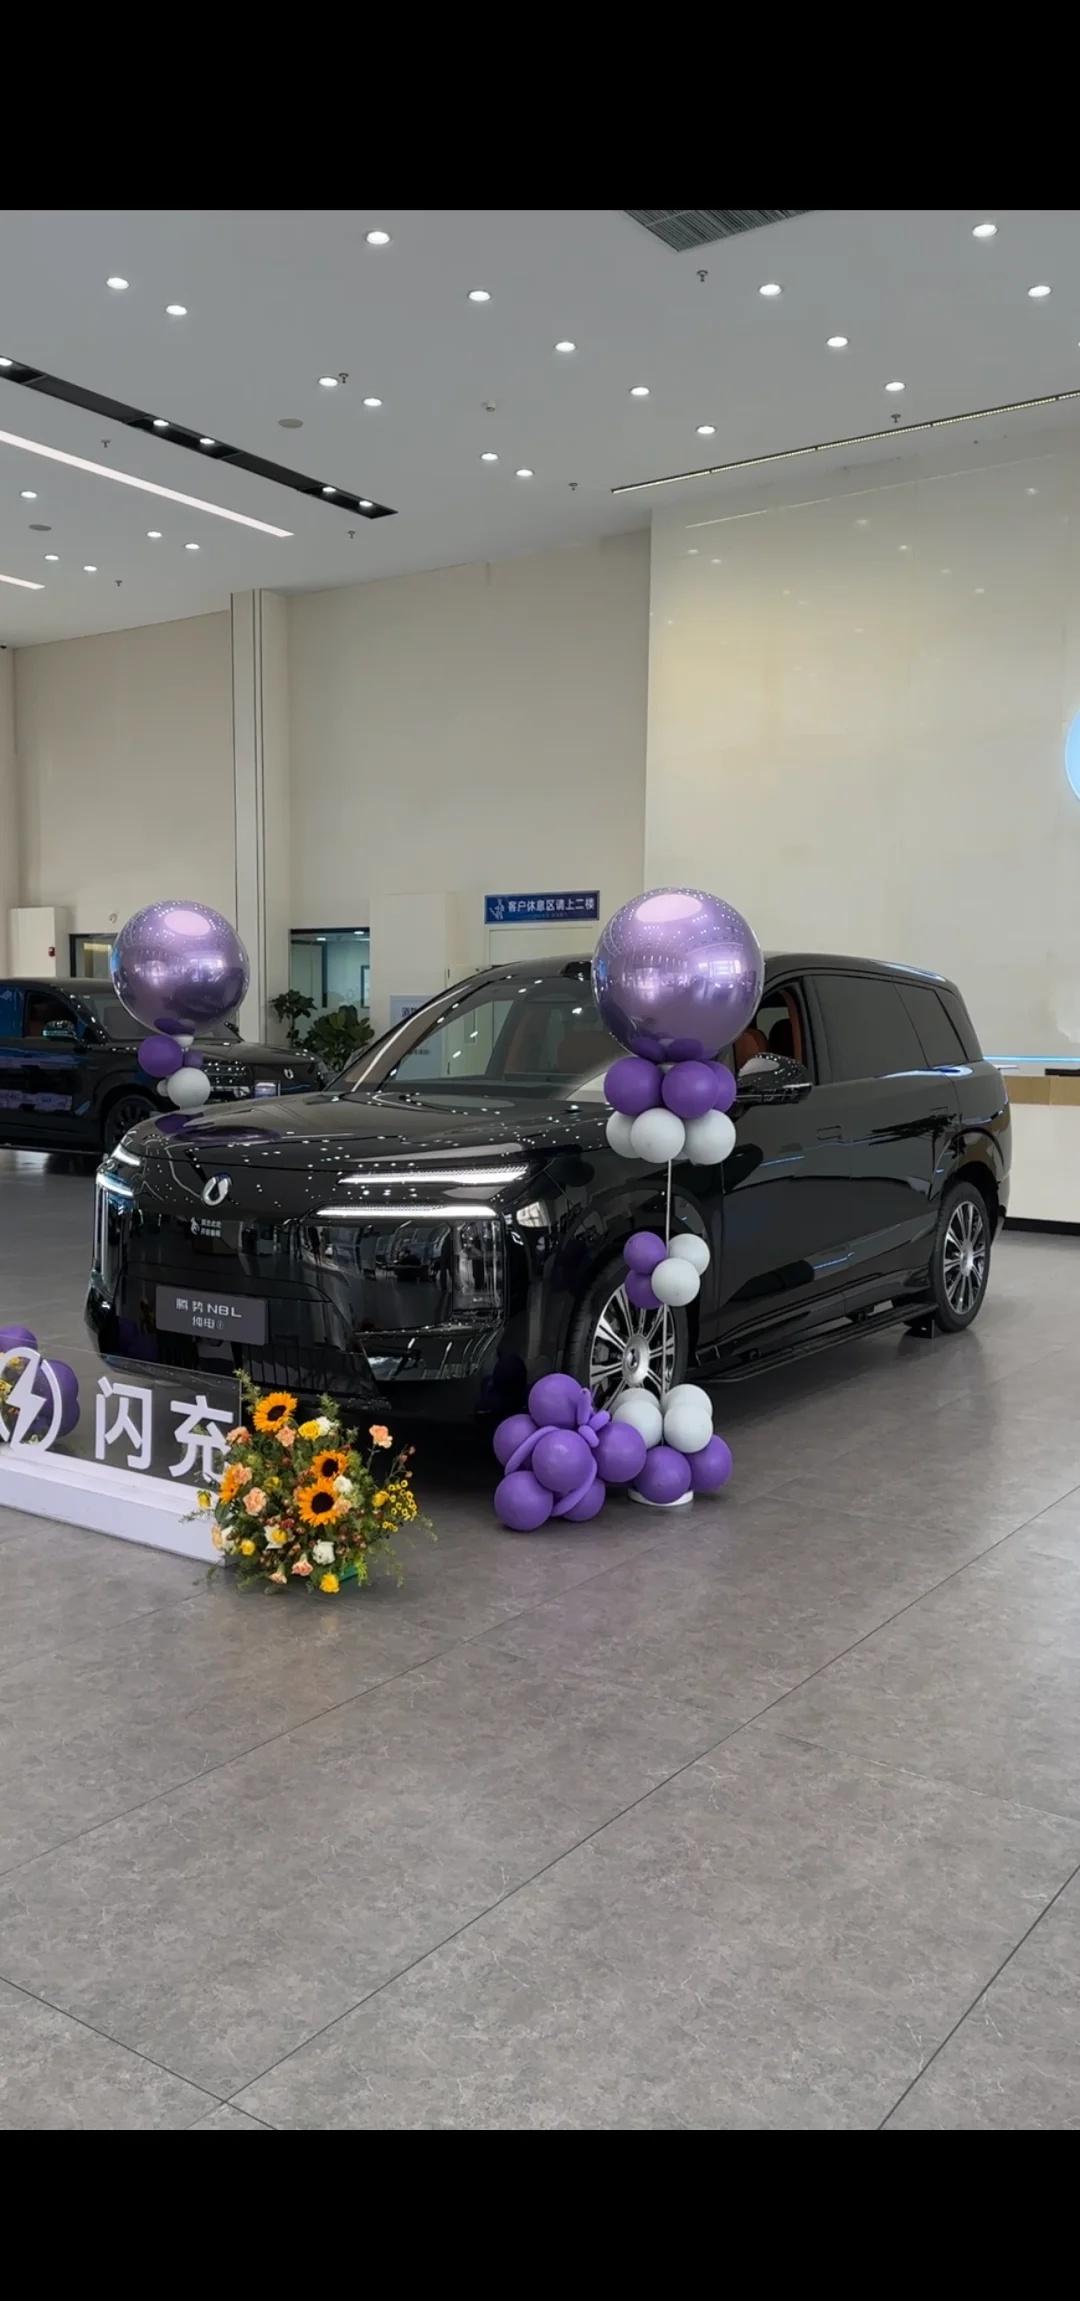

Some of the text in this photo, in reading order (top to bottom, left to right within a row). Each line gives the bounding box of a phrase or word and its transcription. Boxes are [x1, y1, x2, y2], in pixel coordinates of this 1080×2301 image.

[508, 898, 594, 912] 客户休息区请上二楼
[206, 1303, 242, 1318] N8L
[95, 1376, 234, 1485] 闪充
